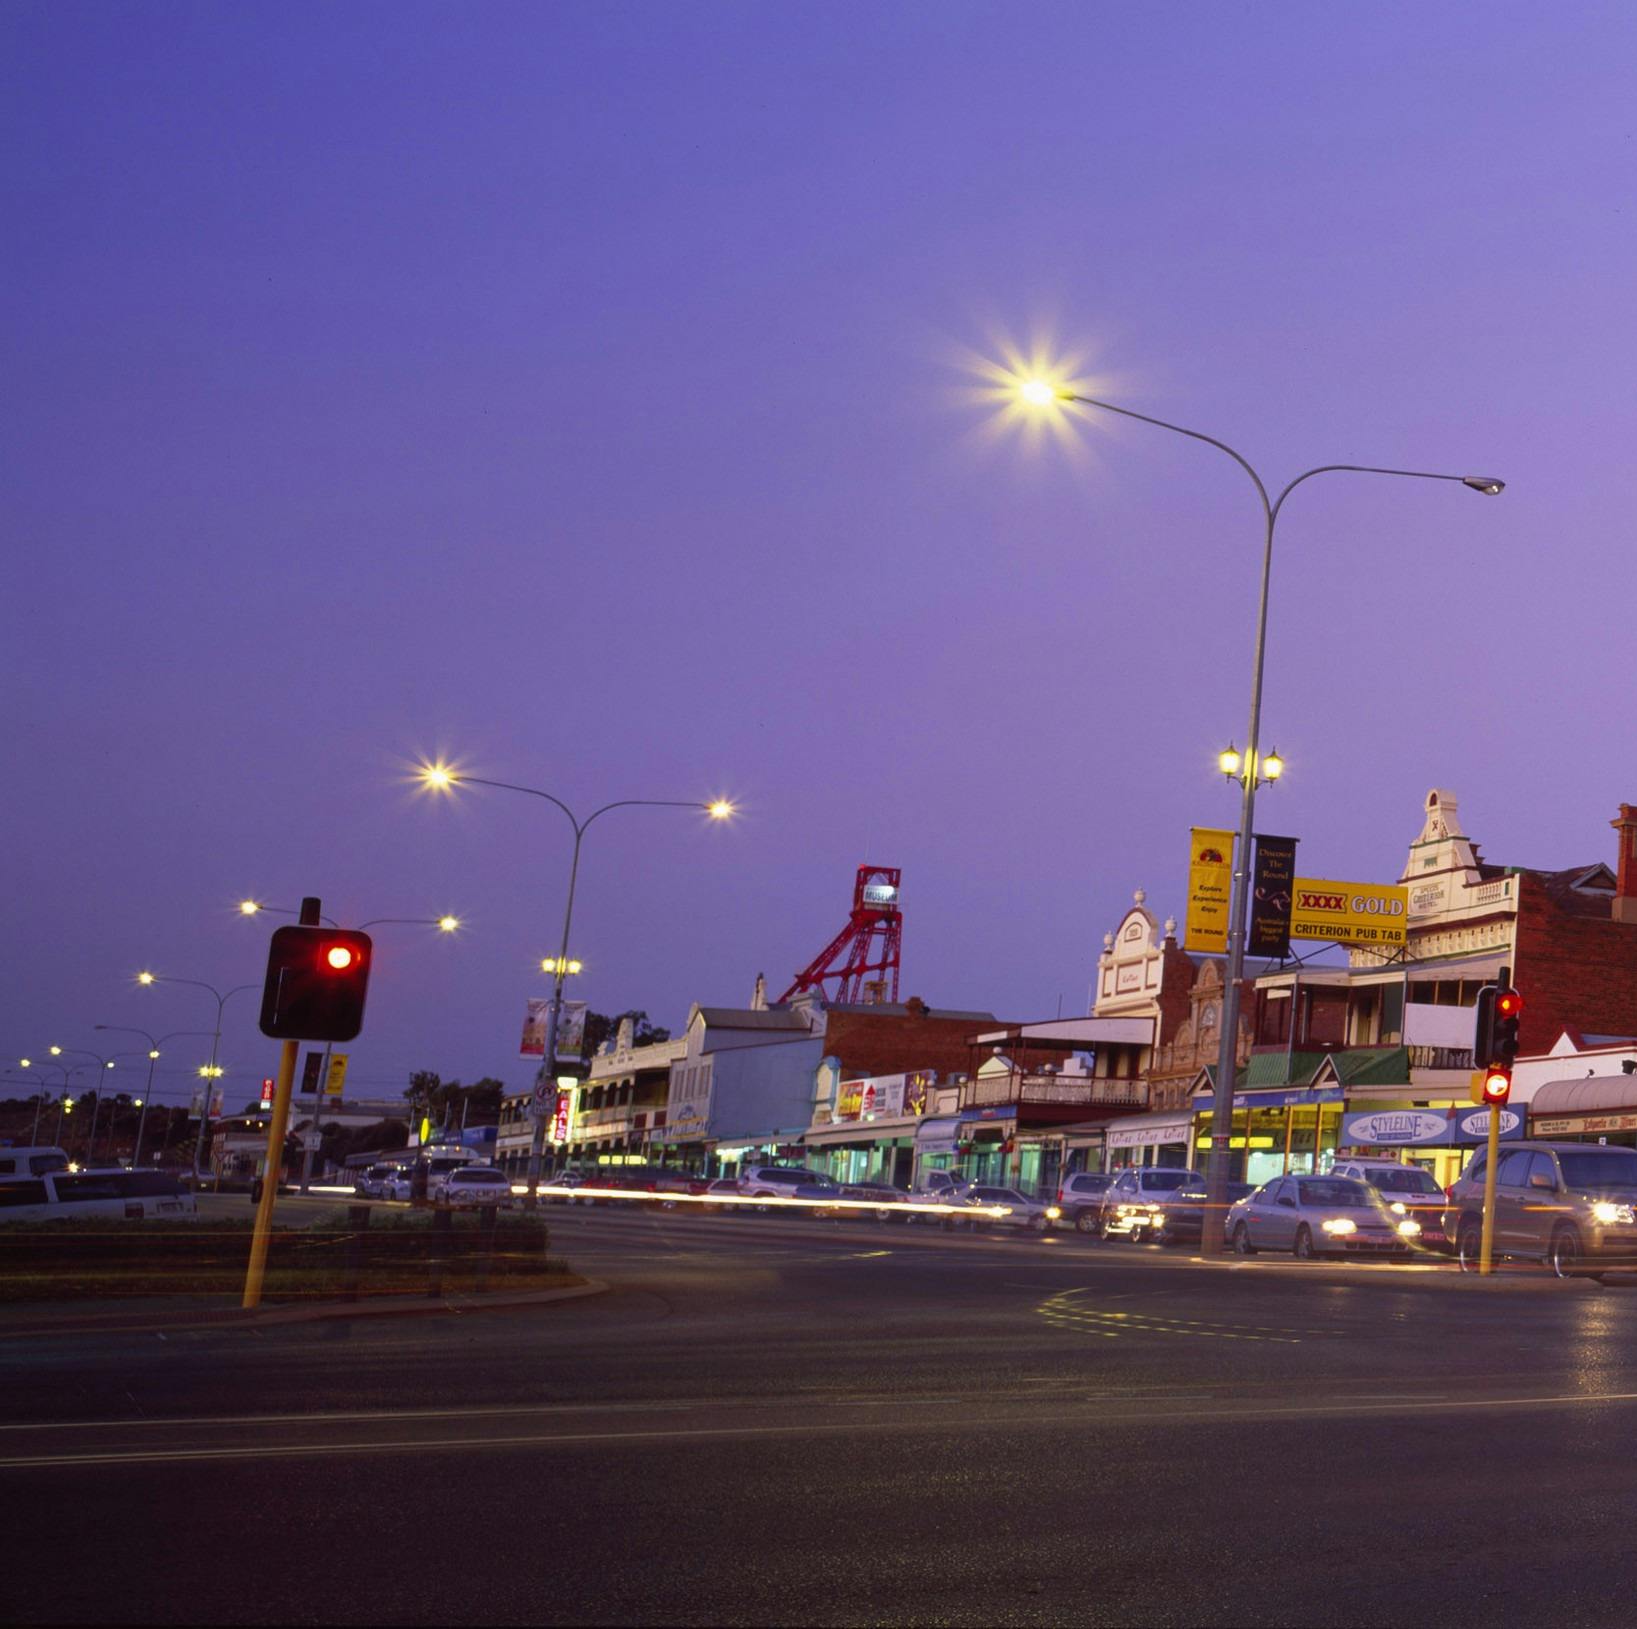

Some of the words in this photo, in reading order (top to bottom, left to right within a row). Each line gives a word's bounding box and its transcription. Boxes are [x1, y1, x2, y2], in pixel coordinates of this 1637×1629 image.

[865, 890, 897, 902] MUSEUM
[1199, 884, 1222, 894] Explore
[1192, 895, 1227, 904] Experience
[1301, 893, 1344, 911] XXXX
[1351, 895, 1404, 916] GOLD
[1295, 923, 1351, 937] CRITERION
[1356, 928, 1377, 939] PUB
[1382, 930, 1402, 941] TAB
[1370, 1115, 1422, 1139] STYLELINE
